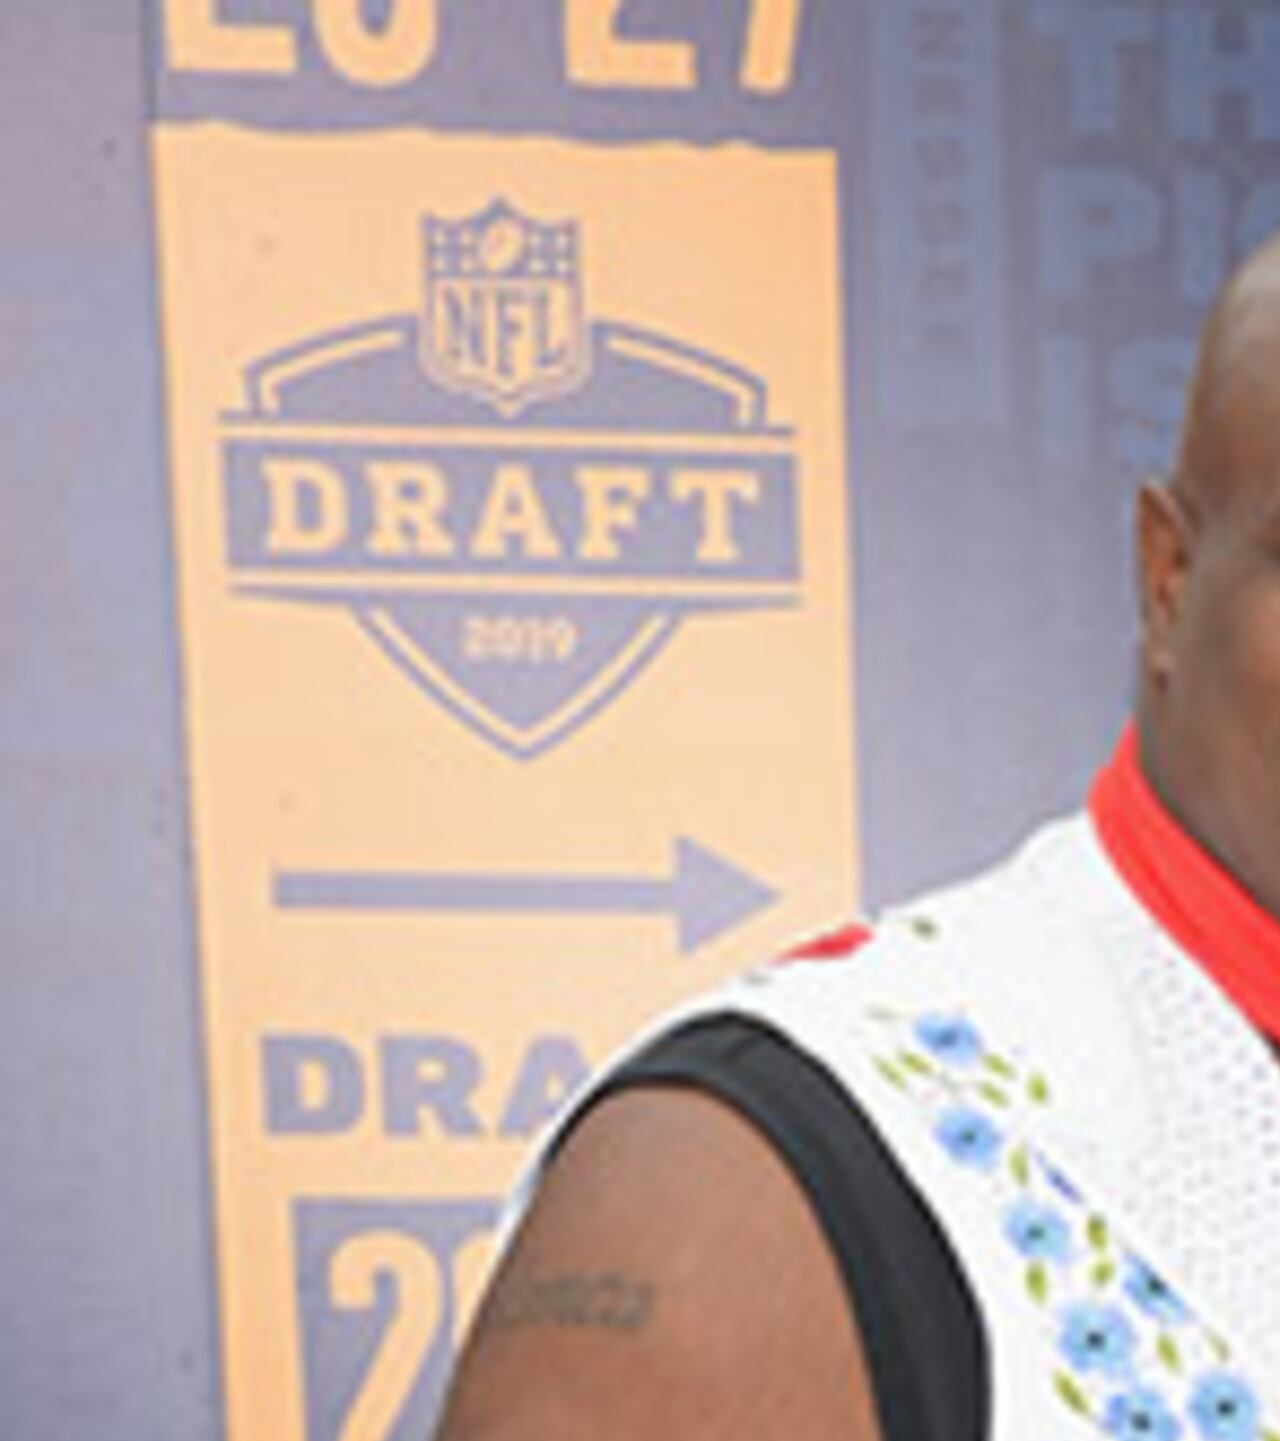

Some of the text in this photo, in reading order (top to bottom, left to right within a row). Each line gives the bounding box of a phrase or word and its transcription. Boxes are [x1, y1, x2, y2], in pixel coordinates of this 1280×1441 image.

[437, 284, 570, 376] NFL
[262, 462, 764, 561] DRAFT
[462, 617, 577, 658] 2019
